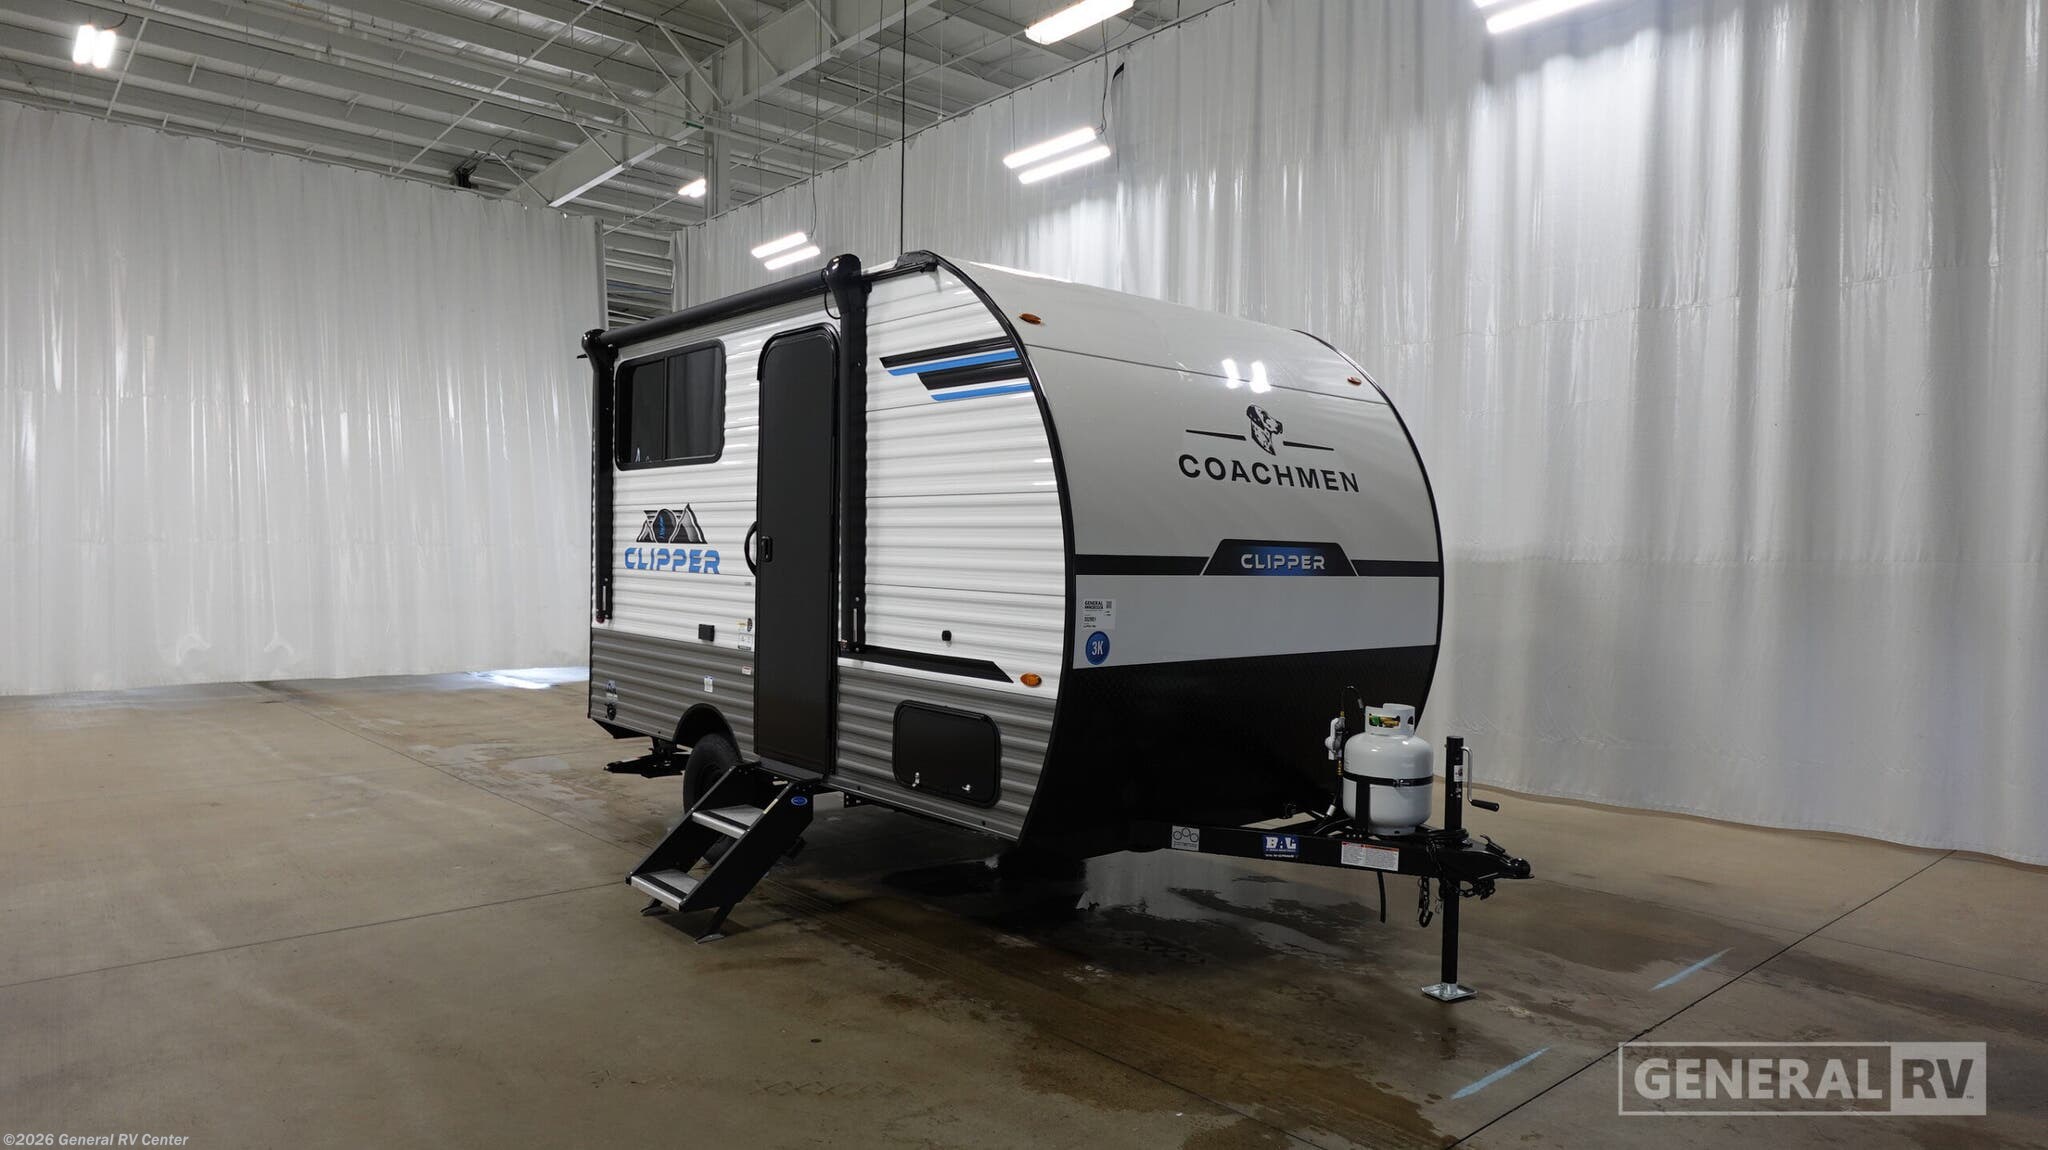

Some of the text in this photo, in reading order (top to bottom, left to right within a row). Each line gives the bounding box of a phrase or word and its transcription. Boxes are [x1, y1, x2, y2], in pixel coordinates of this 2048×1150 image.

[1178, 454, 1360, 493] COACHMEN
[624, 547, 720, 574] CLIPPER
[1241, 553, 1325, 570] CLIPPER
[1091, 640, 1104, 656] 3K
